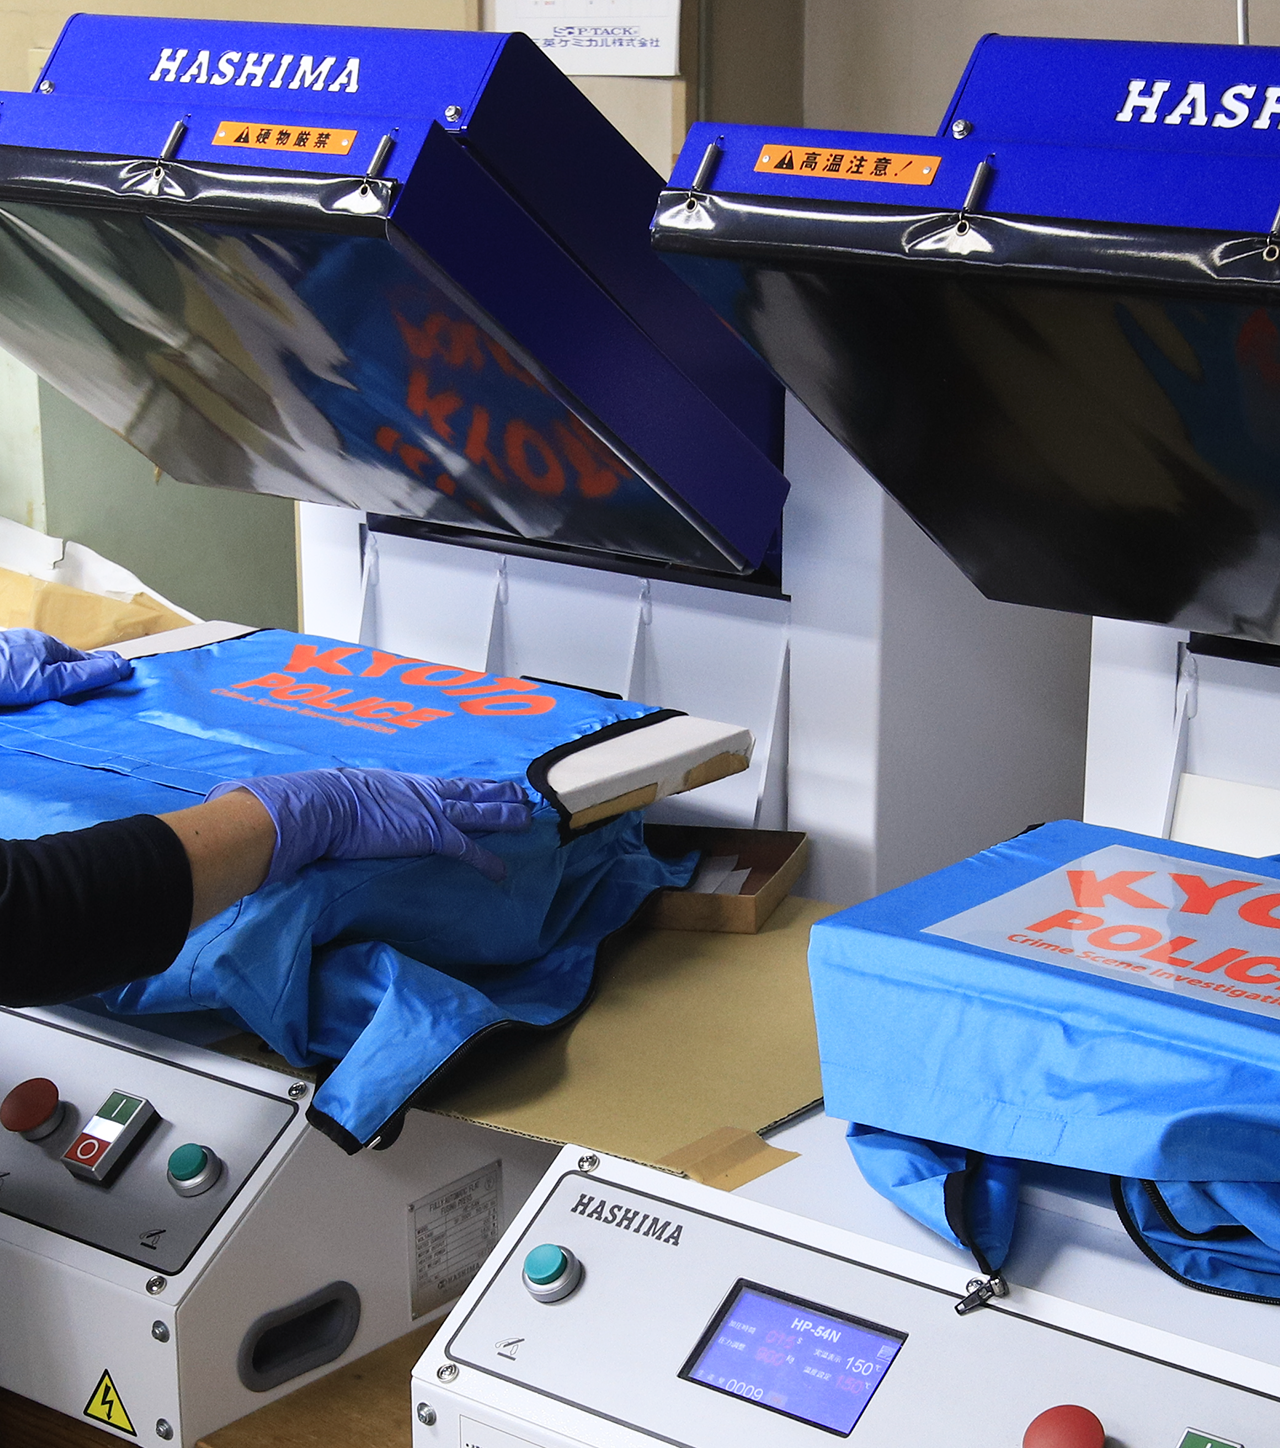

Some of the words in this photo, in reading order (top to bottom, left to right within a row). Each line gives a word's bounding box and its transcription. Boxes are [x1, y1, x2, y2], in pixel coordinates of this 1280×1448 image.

[149, 48, 360, 93] HASHIMA
[255, 128, 331, 149] 硬物厳禁
[283, 644, 556, 716] KYOTO
[231, 672, 454, 728] POLICE
[1007, 934, 1074, 955] Crime
[1076, 950, 1147, 973] Scene
[571, 1193, 683, 1246] HASHIMA
[791, 1317, 842, 1343] HP-54N
[844, 1356, 873, 1376] 150
[725, 1379, 764, 1400] 0009
